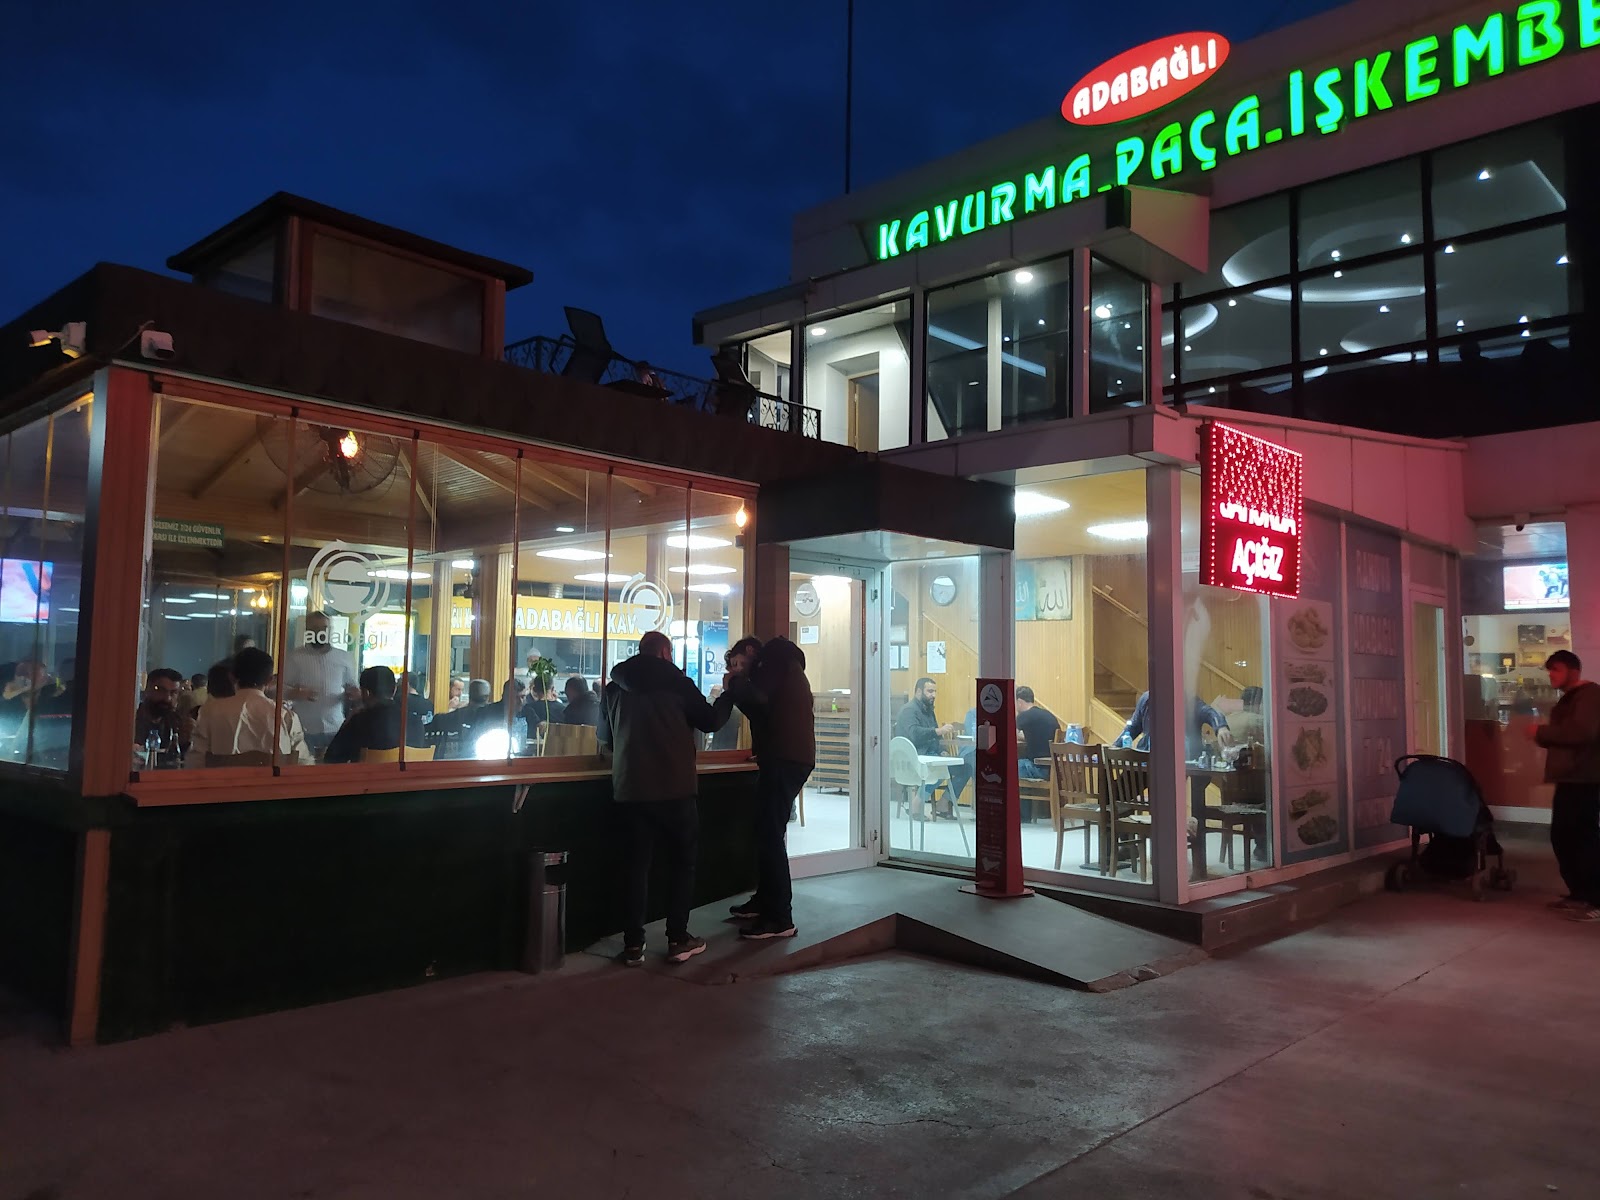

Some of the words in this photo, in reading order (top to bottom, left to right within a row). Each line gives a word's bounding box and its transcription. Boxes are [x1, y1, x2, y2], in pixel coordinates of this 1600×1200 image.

[1072, 38, 1217, 120] ADABAĞLI
[878, 153, 1091, 260] KAVURMA
[304, 627, 389, 650] adabağlı
[515, 606, 600, 633] ADABAĞLI
